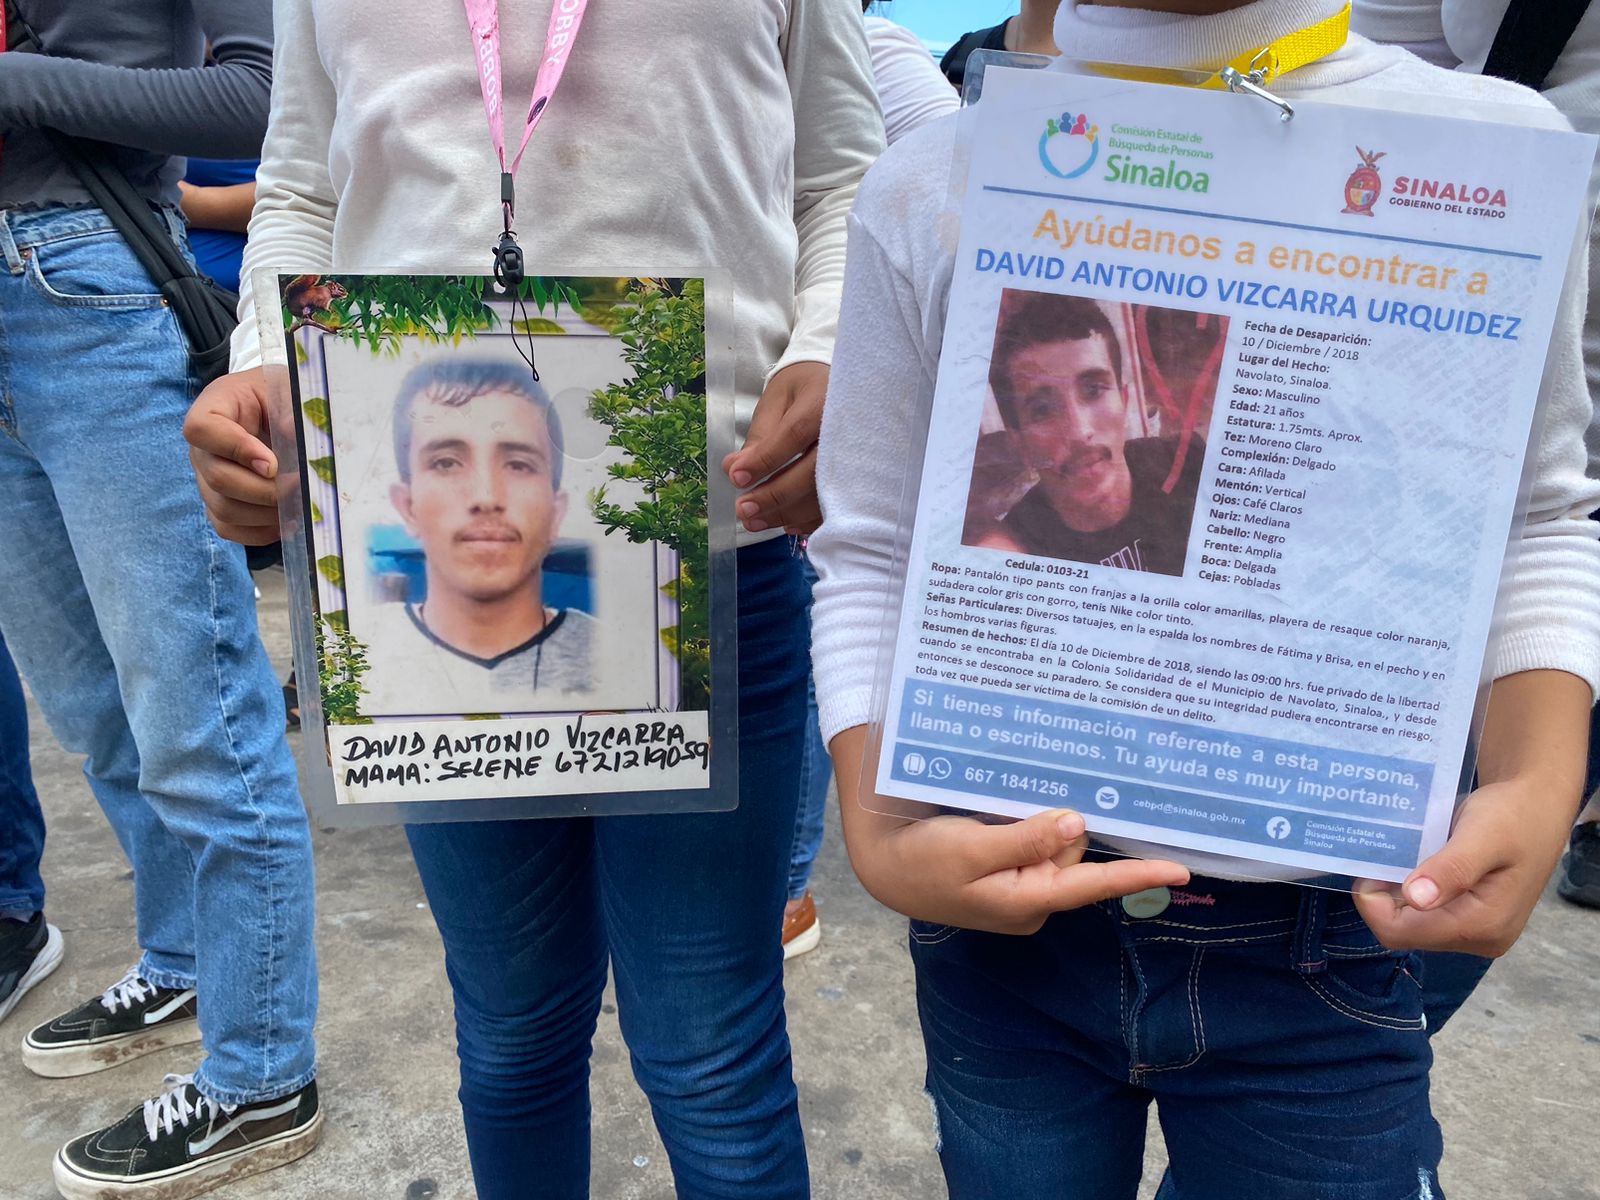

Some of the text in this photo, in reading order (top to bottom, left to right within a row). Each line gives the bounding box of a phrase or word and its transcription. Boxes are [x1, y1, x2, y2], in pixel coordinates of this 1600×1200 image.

[1103, 153, 1209, 193] Sinaloa
[1392, 175, 1506, 207] SINALOA
[1388, 196, 1505, 219] GOBIERNO DEL ESTADO
[1032, 208, 1488, 295] Ayúdanos a encontrar a
[975, 248, 1521, 340] DAVID ANTONIO VIZCARRA URQUIDEZ
[1244, 320, 1371, 346] Fecha de Desaparición:
[1241, 336, 1255, 346] 10
[1265, 338, 1321, 355] Diciembre
[1331, 348, 1359, 360] 2018
[1238, 351, 1330, 373] Lugar del Hecho:
[1235, 367, 1332, 390] Navolato, Sinaloa.
[1232, 384, 1320, 404] Sexo: Masculino
[1229, 399, 1304, 418] Edad: 21 años
[1226, 414, 1362, 442] Estatura: 1.75mts. Aprox.
[1223, 430, 1322, 453] Tez: Moreno Claro
[1220, 446, 1336, 471] Complexión: Delgado
[1217, 462, 1285, 480] Cara: Afilada
[1214, 477, 1306, 499] Mentón: Vertical
[1211, 492, 1302, 514] Ojos: Café Claros
[1209, 508, 1290, 528] Nariz: Mediana
[1206, 523, 1285, 544] Cabello: Negro
[1203, 538, 1282, 559] Frente: Amplia
[1004, 558, 1088, 579] Cedula: 0103-21
[1200, 554, 1276, 574] Boca: Delgada
[1198, 569, 1280, 590] Cejas: Pobladas
[928, 577, 1193, 625] sudadera color gris con gorro, tenis Nike color tinto.
[930, 561, 1450, 650] Ropa: Pantalón tipo pants con franjas a la orilla color amarillas, playera de resaque color naranja,
[921, 620, 1440, 710] Resumen de hechos: El día 10 de Diciembre de 2018, siendo las 09:00 hrs. fue privado de la libertad
[915, 665, 1215, 722] toda vez que pueda ser víctima de la comisión de un delito.
[341, 715, 685, 761] DAVID ANTONIO VIZCARRA
[913, 688, 1419, 790] Si tienes información referente a esta persona,
[345, 763, 431, 788] MAMA:
[437, 756, 542, 782] SELENE
[910, 711, 1415, 811] llama o escribenos. Tu ayuda es muy importante.
[964, 766, 1068, 797] 667 1841256
